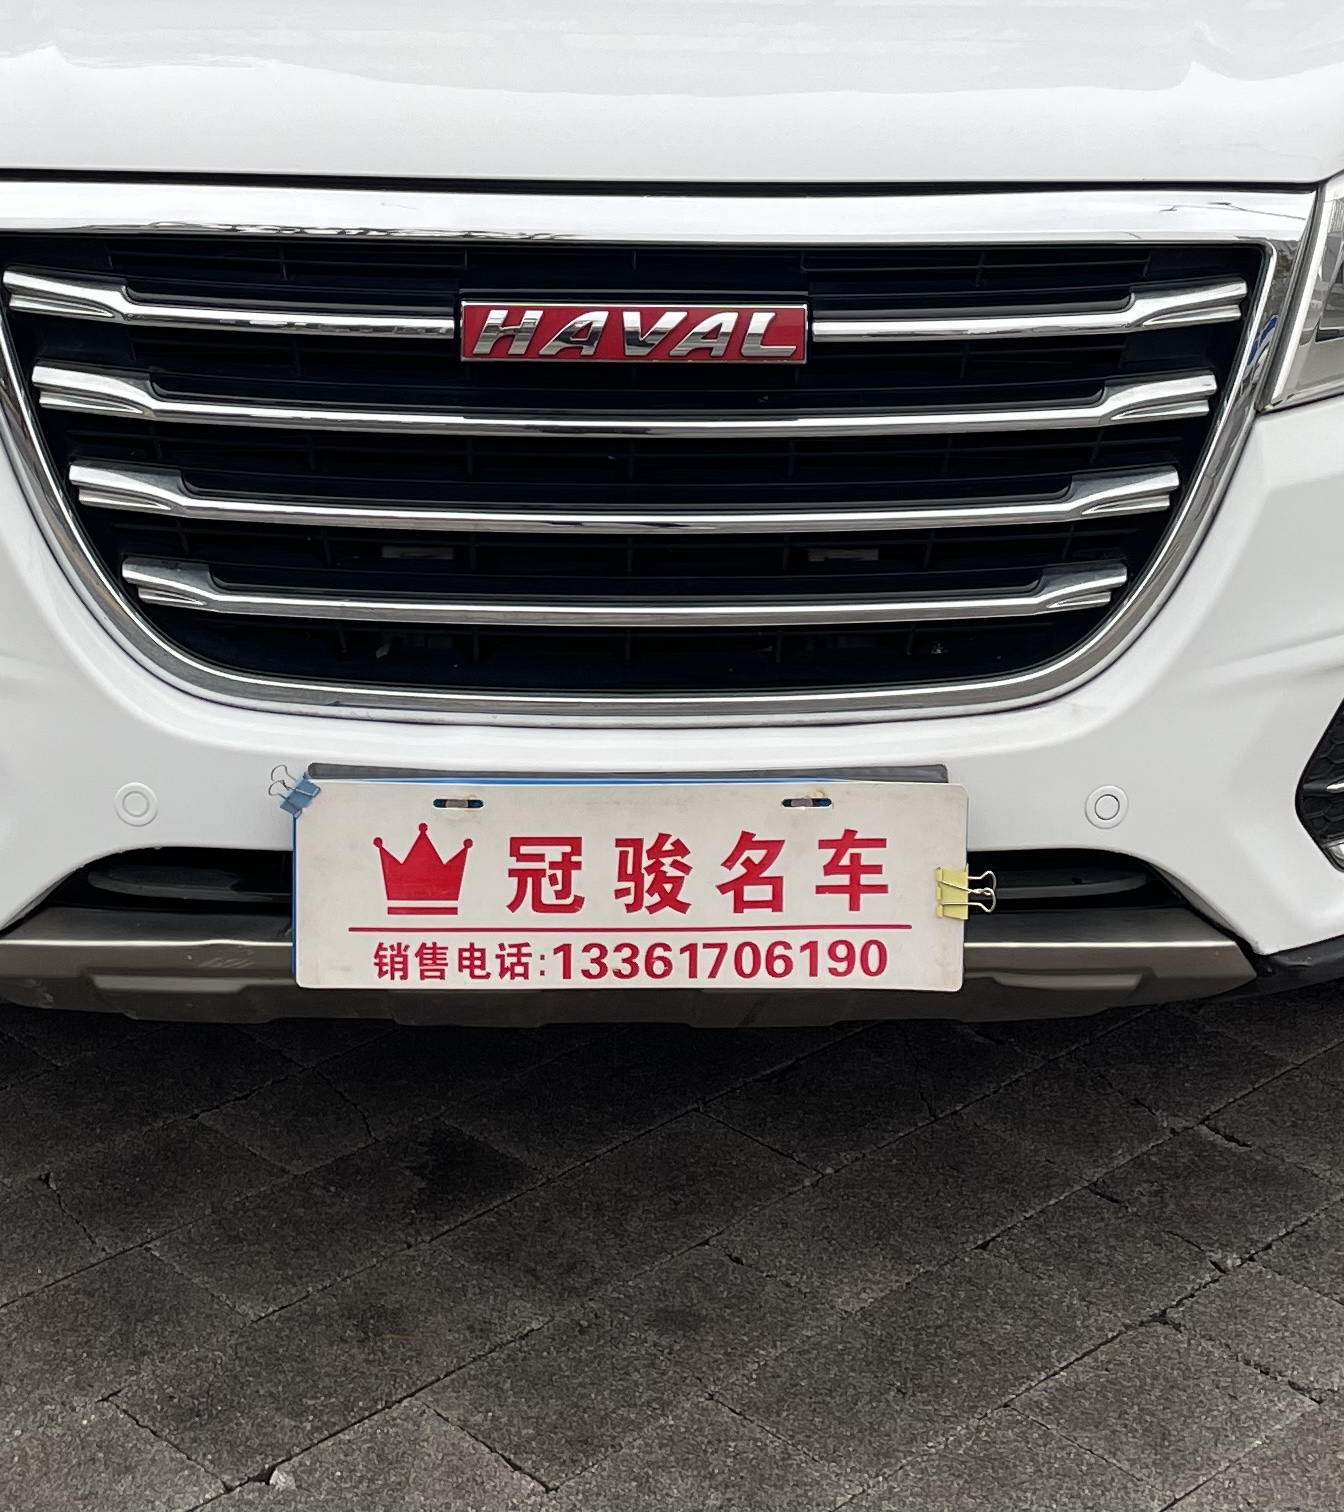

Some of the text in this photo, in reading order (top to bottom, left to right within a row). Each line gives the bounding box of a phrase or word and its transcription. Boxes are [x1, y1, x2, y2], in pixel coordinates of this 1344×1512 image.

[472, 309, 797, 356] HAVAL
[505, 828, 890, 915] 冠骏名车
[373, 939, 889, 982] 销售电话:13361706190
